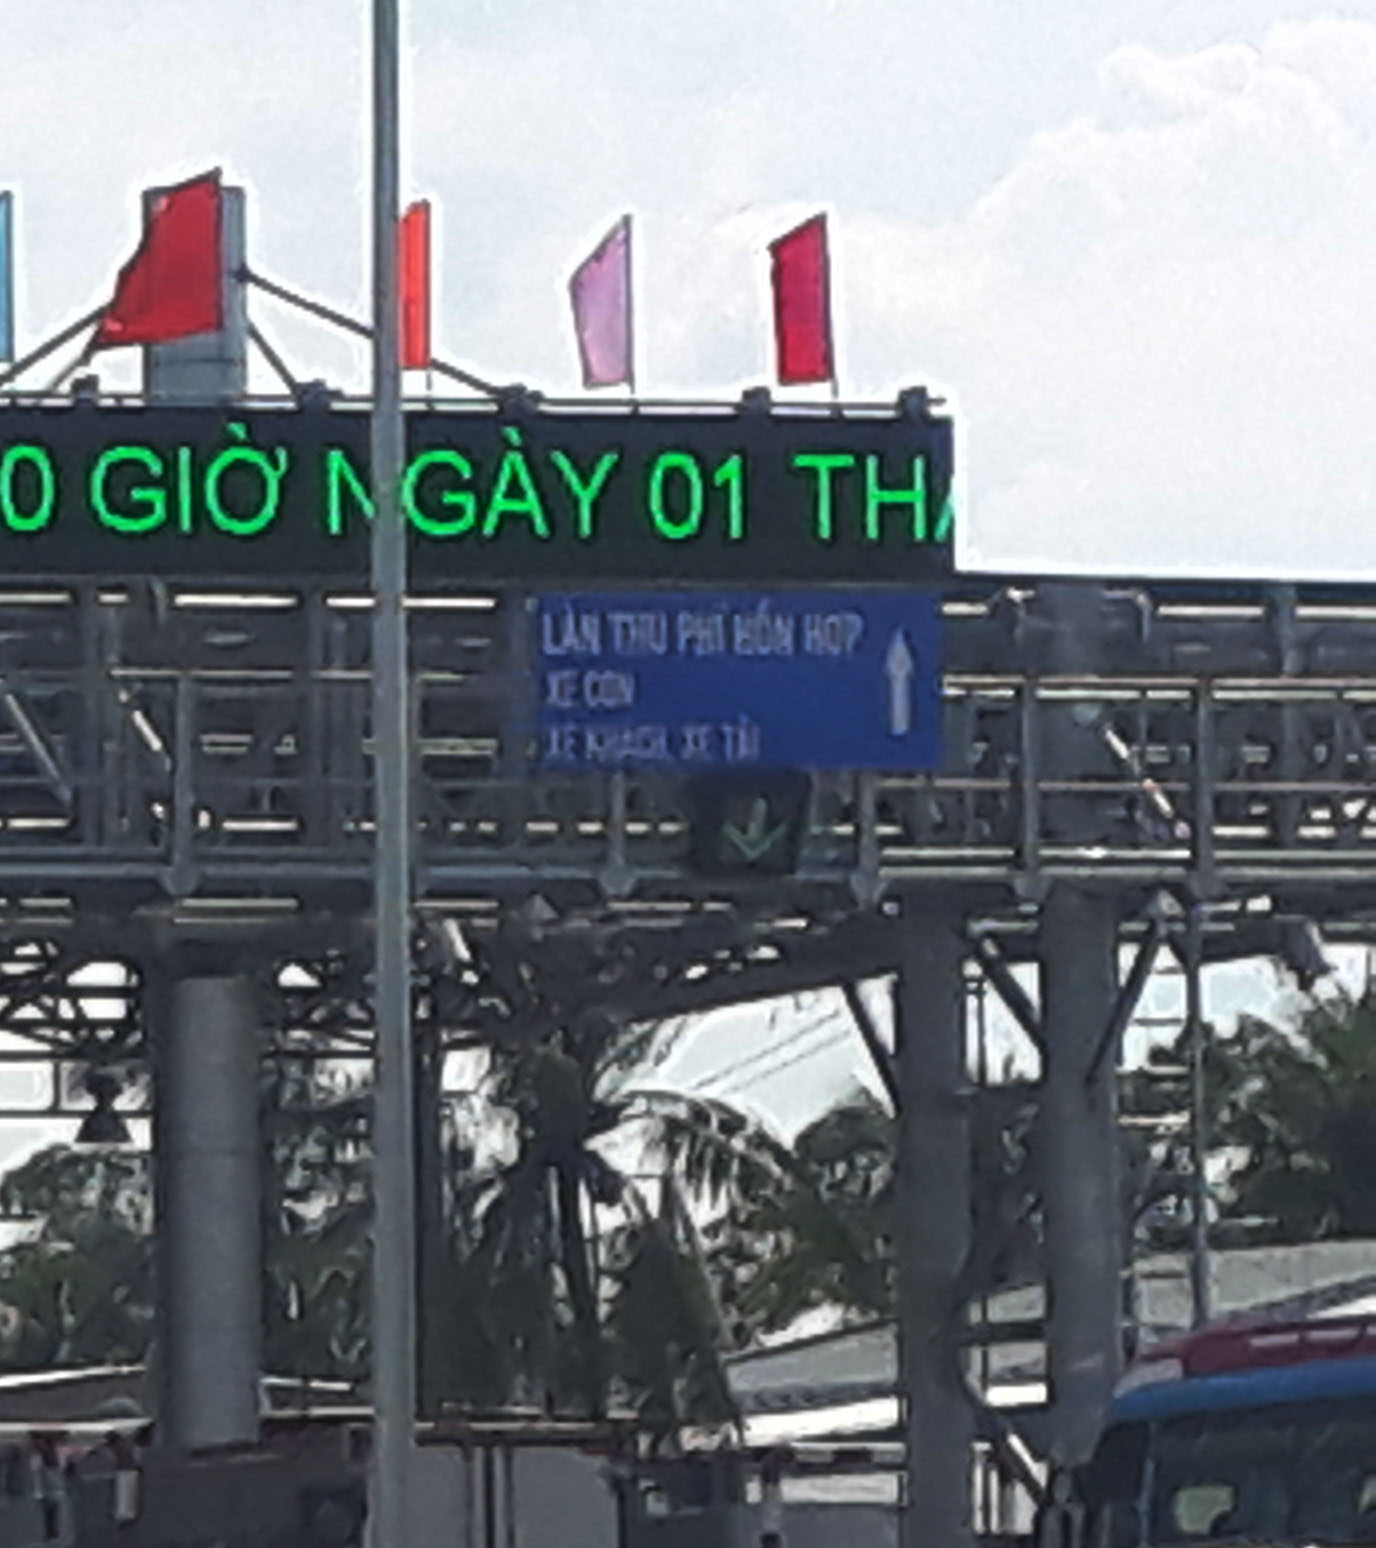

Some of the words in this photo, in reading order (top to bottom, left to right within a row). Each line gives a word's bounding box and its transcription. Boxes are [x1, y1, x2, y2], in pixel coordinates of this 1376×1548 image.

[89, 421, 289, 535] GIỜ
[325, 425, 620, 538] NGÀY
[648, 451, 743, 540] 01
